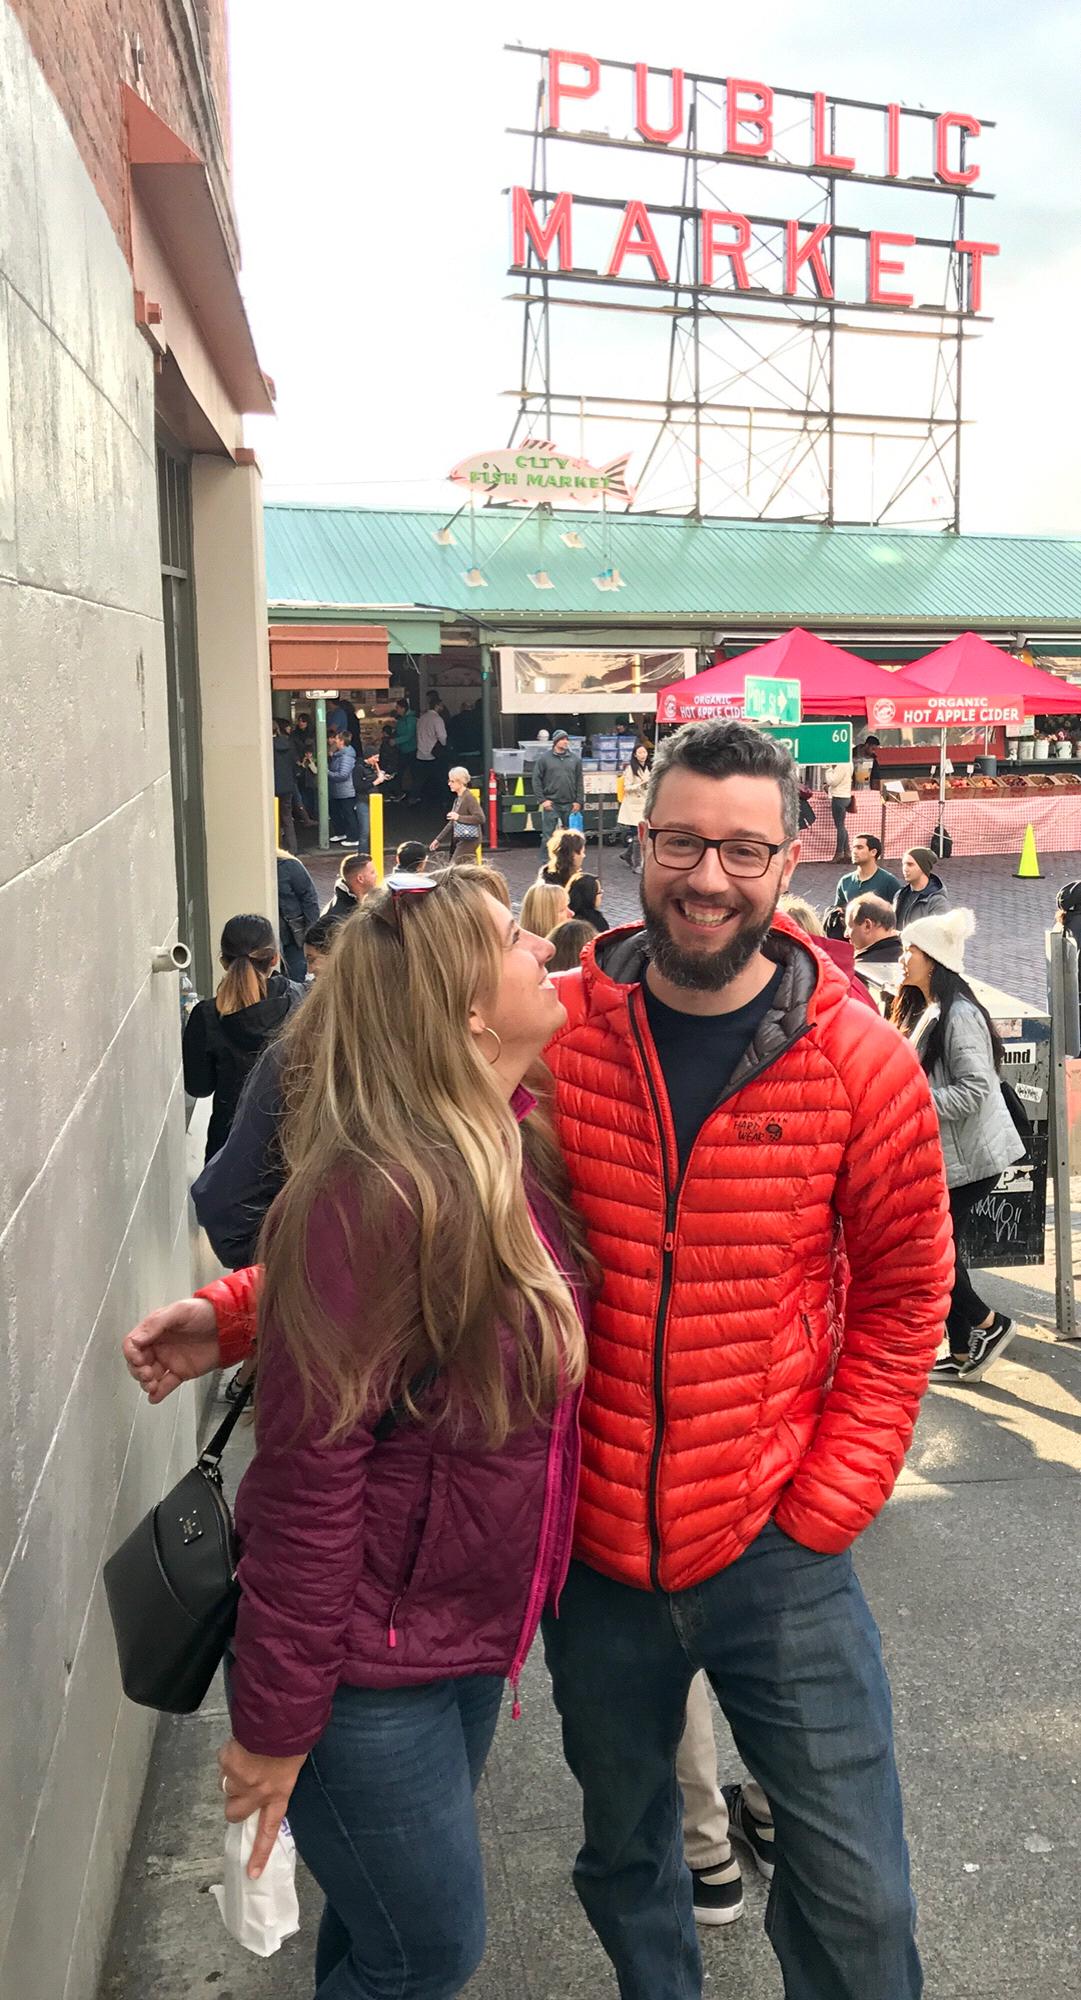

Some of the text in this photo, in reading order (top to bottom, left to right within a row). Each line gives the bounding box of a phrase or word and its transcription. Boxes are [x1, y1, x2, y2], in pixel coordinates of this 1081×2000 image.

[545, 47, 982, 185] PUBLIC
[510, 185, 1000, 313] MARKET
[515, 455, 570, 469] CITY
[469, 471, 610, 489] FISH MARKET
[693, 695, 732, 705] ORGANIC
[928, 698, 988, 708] ORGANIC
[680, 706, 696, 719] HOT
[697, 706, 722, 719] APPLE
[904, 710, 931, 723] HOT
[935, 708, 975, 723] APPLE
[979, 708, 1019, 722] CIDER
[831, 729, 848, 743] 60
[1001, 1049, 1031, 1064] und
